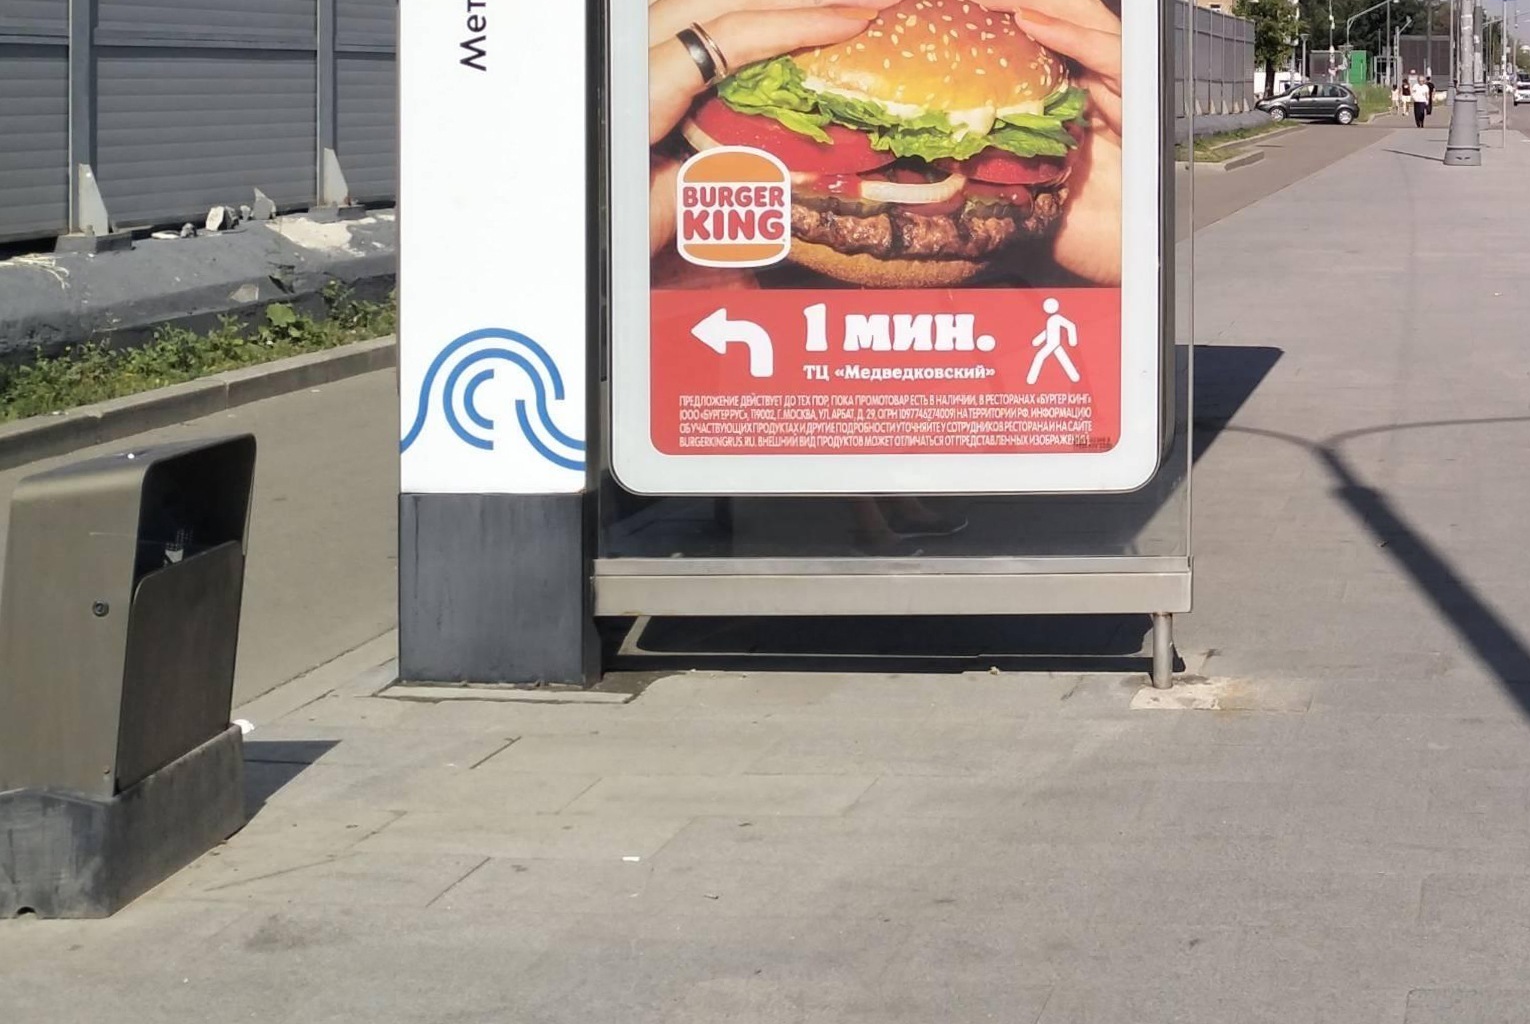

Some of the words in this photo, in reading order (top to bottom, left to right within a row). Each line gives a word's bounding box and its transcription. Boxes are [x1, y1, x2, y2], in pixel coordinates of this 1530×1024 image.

[682, 186, 785, 208] BURGER
[682, 209, 785, 241] KING
[803, 303, 828, 351] 1
[843, 313, 996, 352] мин.
[803, 365, 830, 383] ТЦ
[834, 364, 996, 381] «Медведковский»
[680, 395, 739, 407] ПРЕДЛОЖЕНИЕ
[740, 393, 782, 407] ДЕЙСТВУЕТ
[784, 395, 796, 407] ДО
[797, 395, 811, 406] ТЕХ
[830, 395, 854, 405] ПОКА
[855, 395, 910, 405] ПРОМОТОВАР
[910, 395, 928, 405] ЕСТЬ
[985, 394, 1036, 405] РЕСТОРАНАХ
[968, 408, 1016, 418] ТЕРРИТОРИИ
[1030, 408, 1092, 420] ИНФОРМАЦИЮ
[1068, 419, 1093, 432] САЙТЕ
[758, 434, 799, 447] ВНЕШНИЙ
[799, 436, 816, 448] ВИД
[816, 436, 864, 448] ПРОДУКТОВ
[864, 436, 894, 446] МОЖЕТ
[894, 436, 944, 446] ОТЛИЧАТЬСЯ
[956, 435, 1030, 447] ПРЕДСТАВЛЕННЫХ
